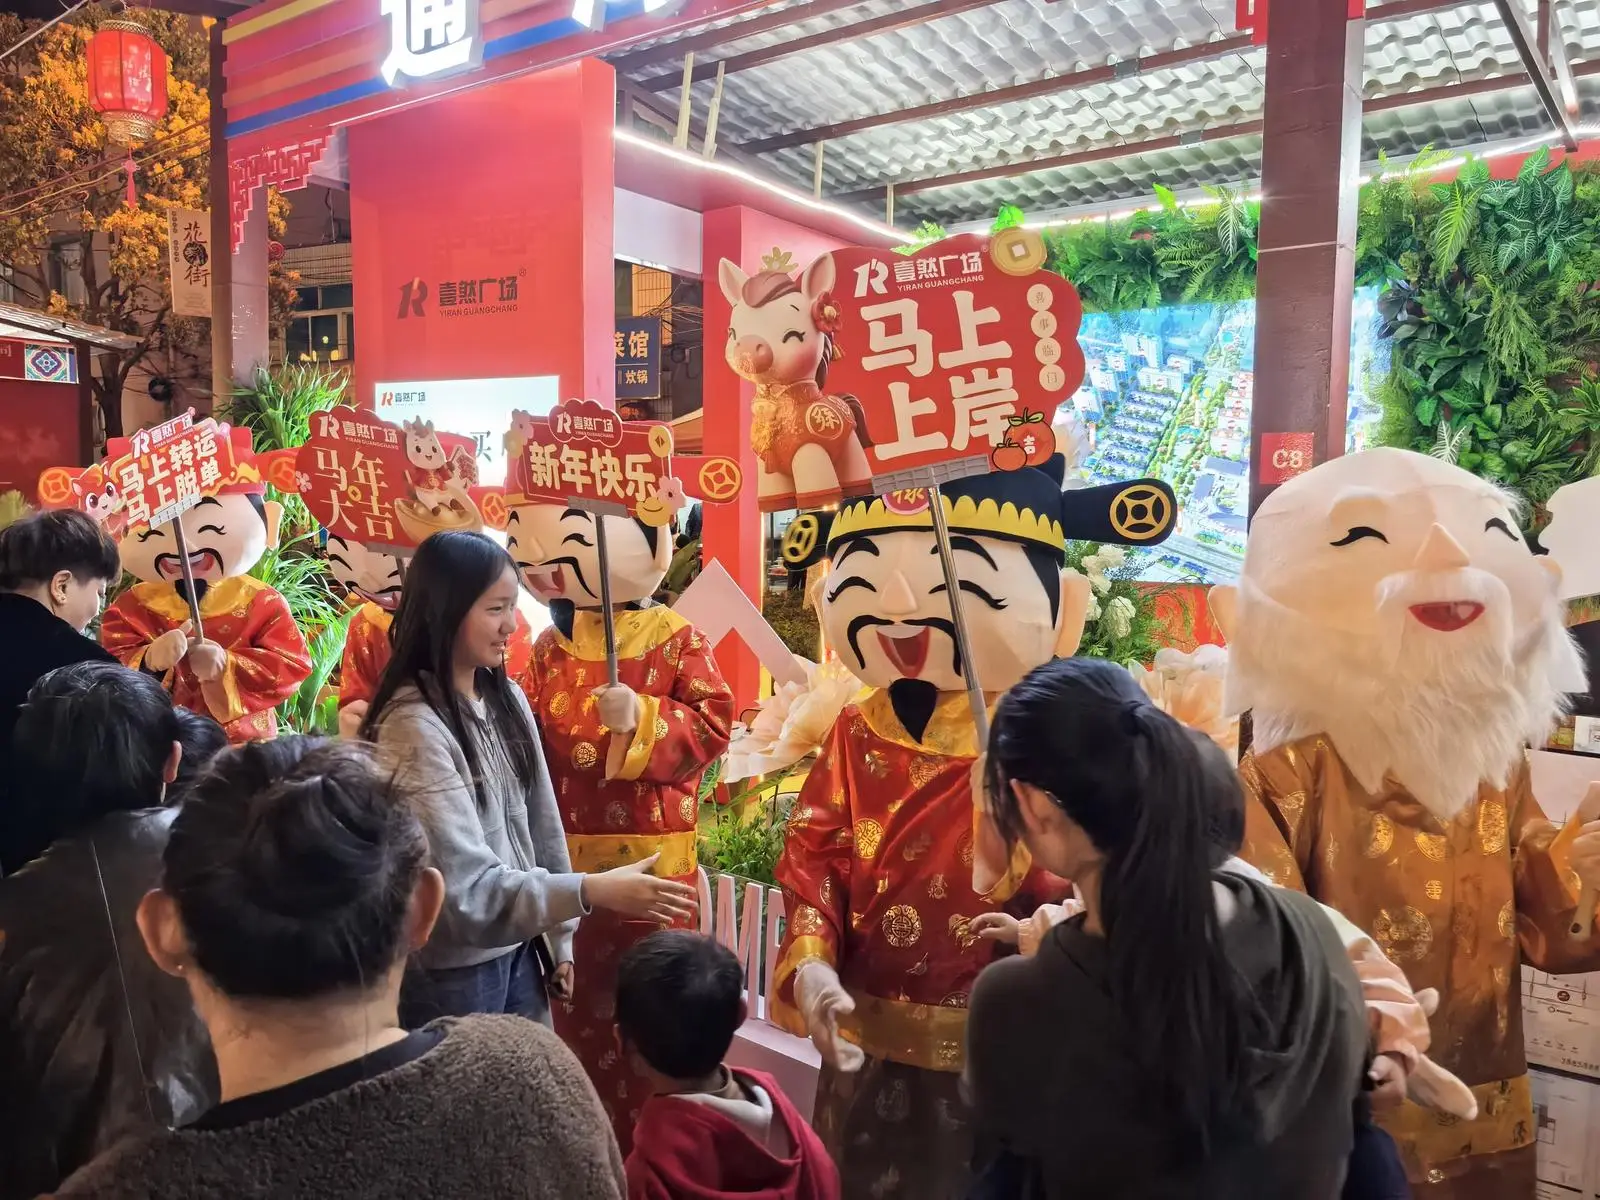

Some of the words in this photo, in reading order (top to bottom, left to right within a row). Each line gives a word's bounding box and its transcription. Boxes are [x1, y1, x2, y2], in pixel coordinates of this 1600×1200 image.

[893, 251, 983, 283] 壹然广场
[897, 282, 923, 292] YIRAN
[924, 274, 985, 290] GUANGCHANG
[439, 276, 518, 307] 壹然广场
[439, 309, 464, 318] YIRAN
[464, 304, 518, 316] GUANGCHANG
[860, 290, 1013, 377] 马上
[573, 416, 614, 433] 壹然广场
[874, 367, 1019, 461] 上岸
[343, 420, 398, 444] 壹然广场
[1023, 435, 1036, 455] 吉
[120, 428, 218, 493] 马上转运
[312, 446, 389, 498] 马年
[529, 441, 658, 502] 新年快乐
[1273, 449, 1304, 469] C8
[127, 457, 222, 525] 马上脱单
[319, 488, 395, 541] 大吉
